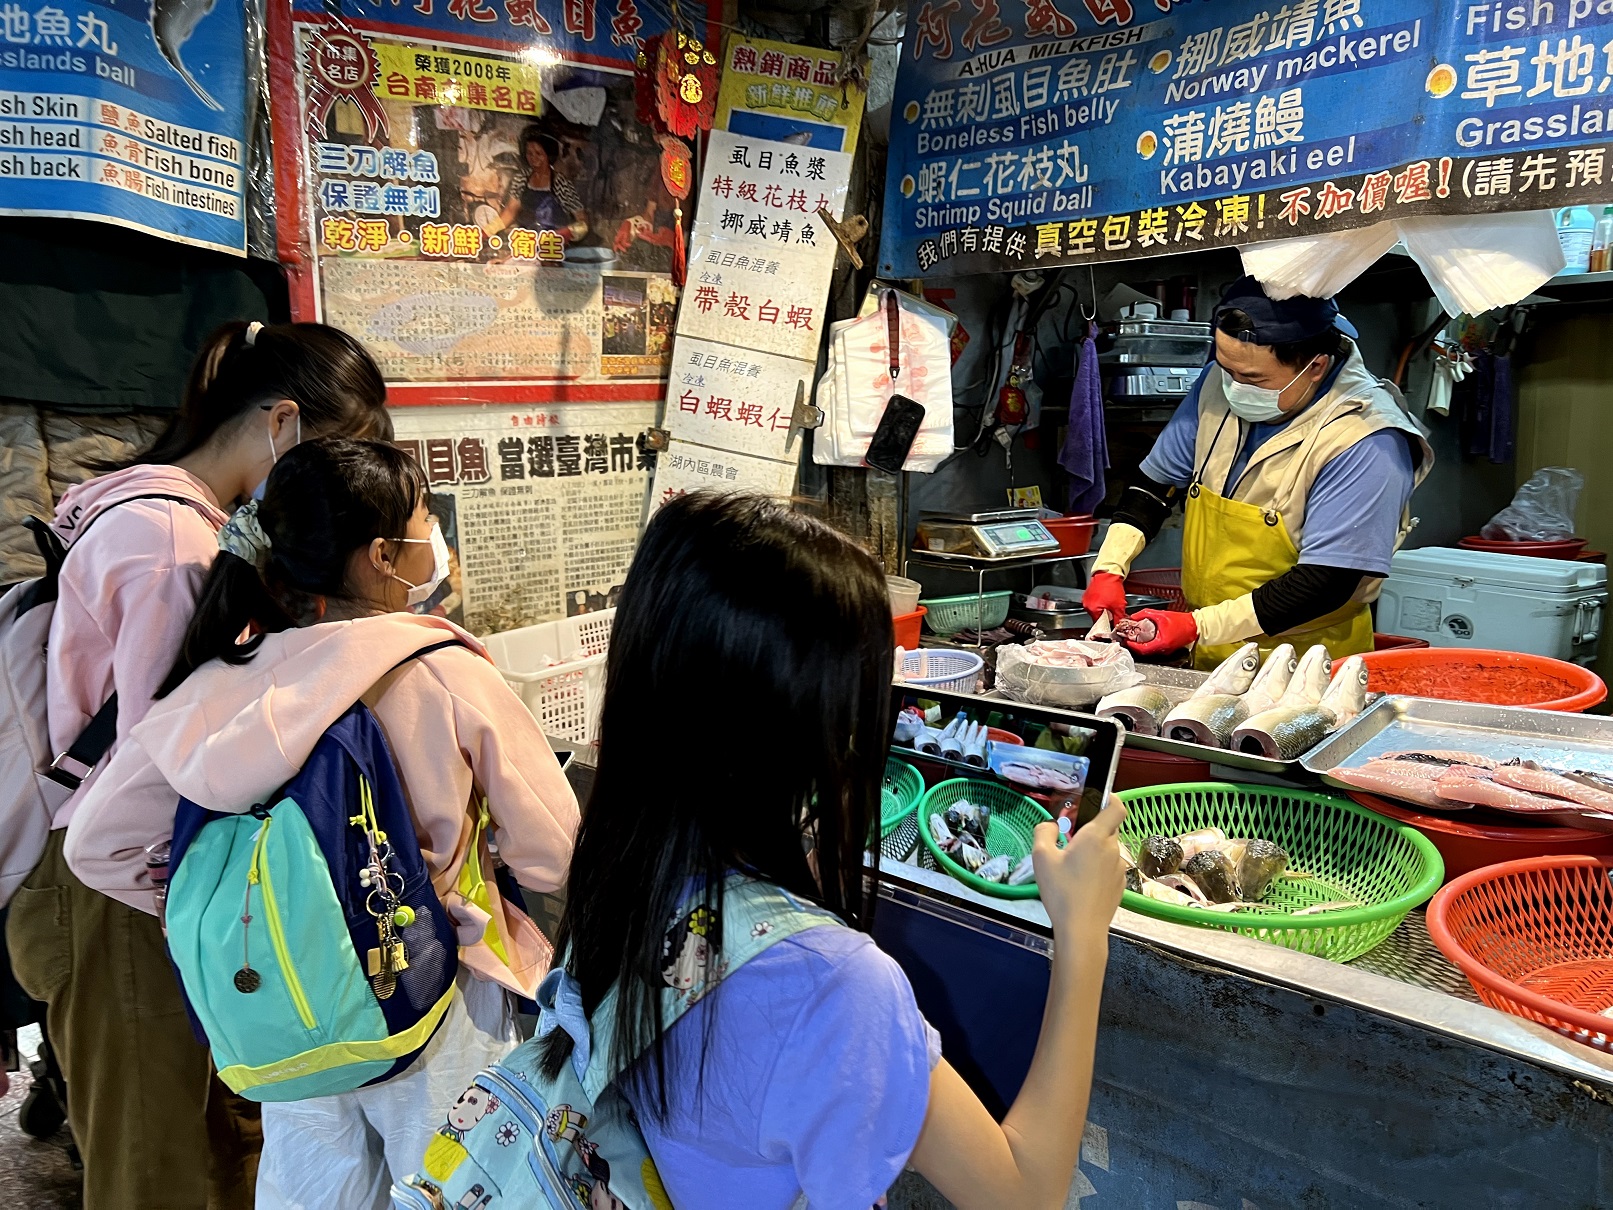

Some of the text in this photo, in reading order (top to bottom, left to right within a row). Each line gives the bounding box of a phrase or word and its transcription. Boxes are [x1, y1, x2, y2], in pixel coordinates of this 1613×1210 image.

[1466, 0, 1553, 35] Fish
[0, 49, 135, 88] slands ball
[327, 63, 359, 81] 名店
[414, 54, 511, 82] 榮獲2008年
[732, 46, 839, 86] 熱銷商品
[959, 27, 1144, 77] A-HUA MILKFISH
[1164, 20, 1421, 105] Norway mackerel
[1461, 35, 1613, 108] 草地
[33, 96, 78, 118] Skin
[921, 49, 1138, 130] 無刺虱目魚肚
[31, 126, 80, 148] head
[144, 119, 203, 152] Salted
[207, 136, 237, 161] fish
[917, 97, 1120, 154] Boneless Fish belly
[1162, 87, 1305, 166] 蒲燒鰻
[31, 156, 81, 178] back
[99, 133, 235, 188] 魚骨 Fish bone
[319, 142, 440, 182] 三刀解魚
[729, 145, 827, 181] 虱目魚漿
[917, 139, 1090, 204] 蝦仁花枝丸
[1159, 136, 1355, 195] Kabayaki eel
[99, 162, 235, 216] 魚腸 Fish intestines
[321, 180, 441, 217] 保證無刺
[711, 175, 834, 216] 特級花枝丸
[915, 185, 1093, 229] Shrimp Squid ball
[917, 224, 1027, 271] 我們有提供
[1462, 148, 1613, 199] (請先預
[705, 250, 781, 276] 虱目魚混養
[694, 285, 814, 331] 帶殼白蝦
[688, 352, 763, 379] 虱目魚混養
[679, 389, 791, 432] 白蝦蝦仁
[669, 454, 739, 481] 湖內區農會
